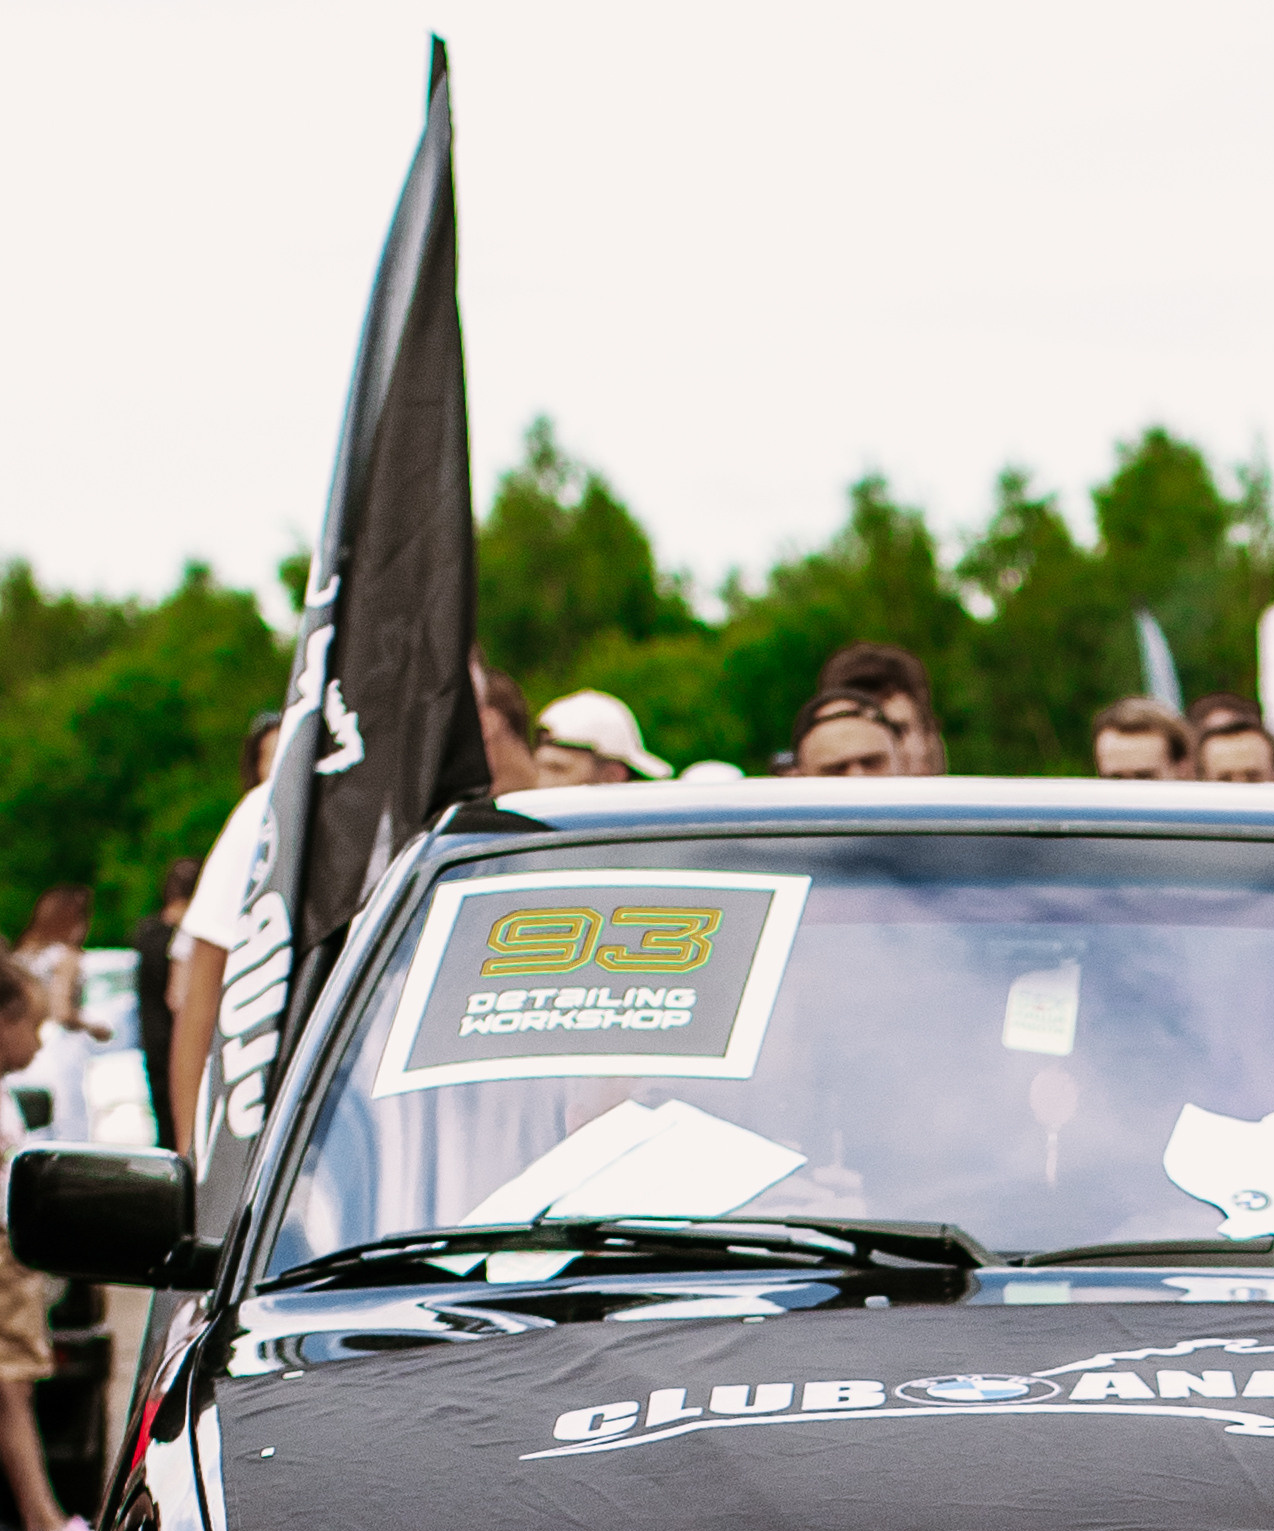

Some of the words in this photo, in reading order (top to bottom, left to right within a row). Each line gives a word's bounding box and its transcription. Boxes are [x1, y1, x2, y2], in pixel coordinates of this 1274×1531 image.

[480, 906, 724, 977] 93
[458, 1008, 692, 1037] WORKSHOP
[552, 1380, 888, 1442] CLUB
